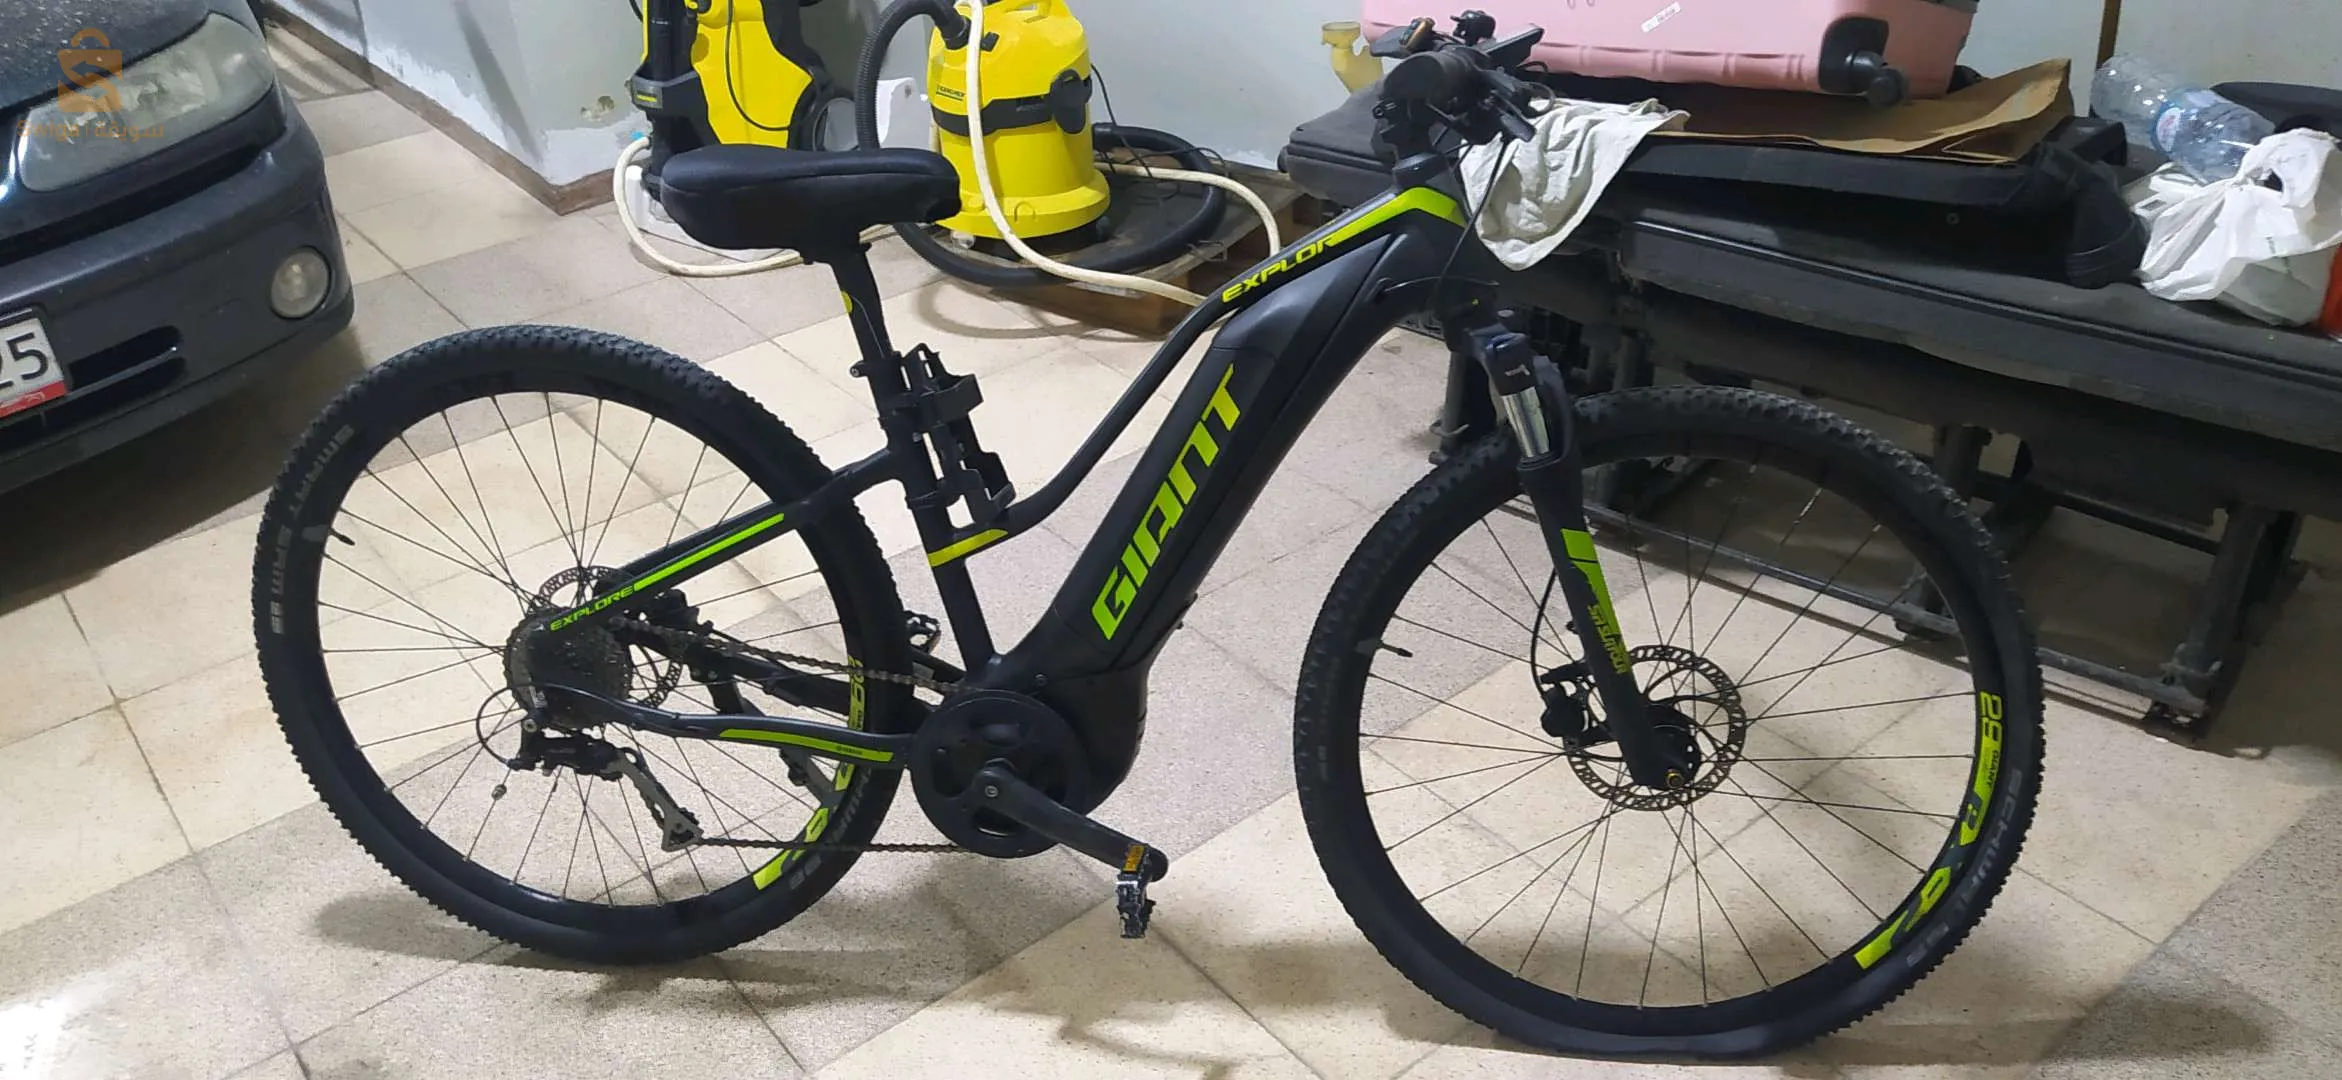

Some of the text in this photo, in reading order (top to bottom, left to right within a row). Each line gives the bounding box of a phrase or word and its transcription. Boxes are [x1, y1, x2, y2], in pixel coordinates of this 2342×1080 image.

[1091, 362, 1241, 640] GIANT
[551, 585, 634, 631] EXPLORE
[1979, 691, 2003, 742] 29
[1986, 749, 2001, 787] GIANT
